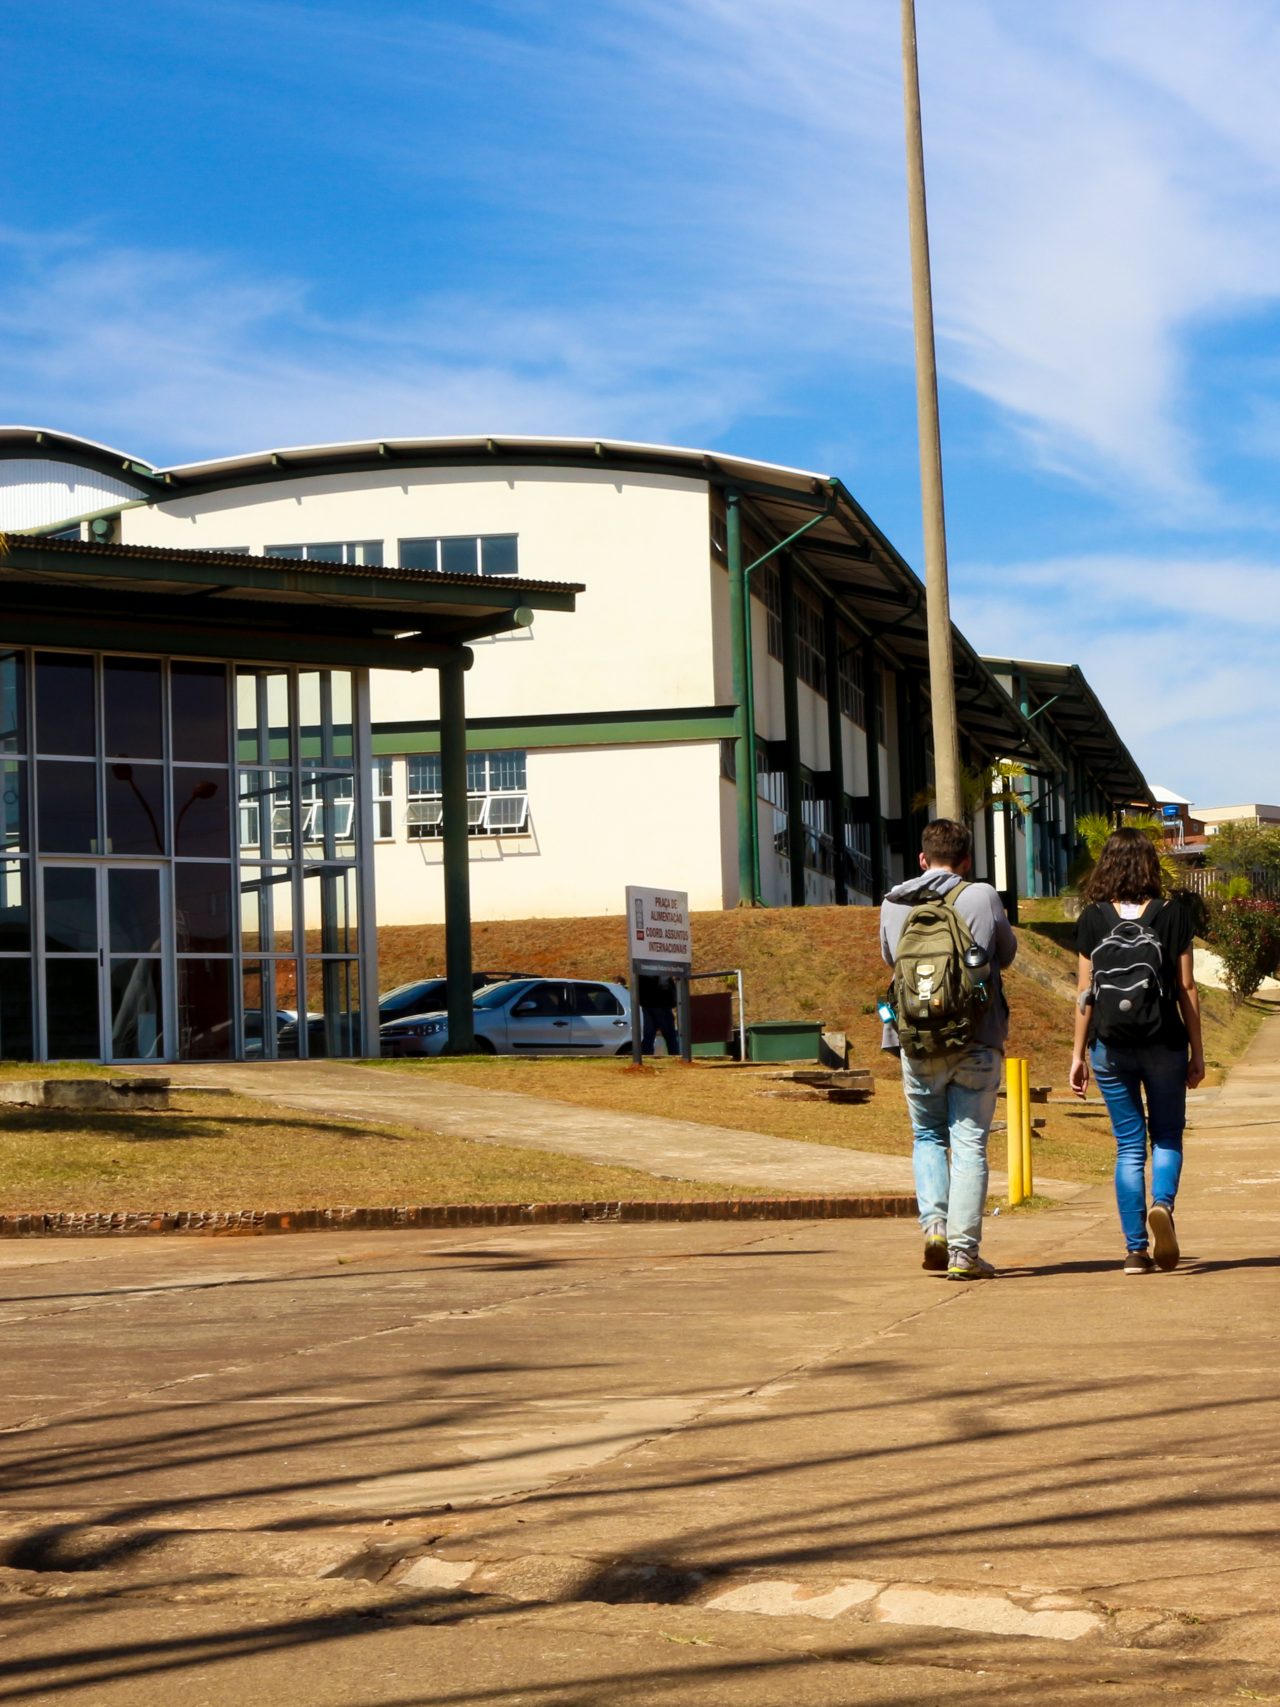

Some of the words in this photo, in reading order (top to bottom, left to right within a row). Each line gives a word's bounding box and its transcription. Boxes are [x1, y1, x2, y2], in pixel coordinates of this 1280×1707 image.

[655, 897, 670, 910] PRAÇA
[671, 899, 678, 909] DE
[664, 929, 688, 941] ASSUNTOS
[648, 941, 687, 954] INTERNACIONAIS
